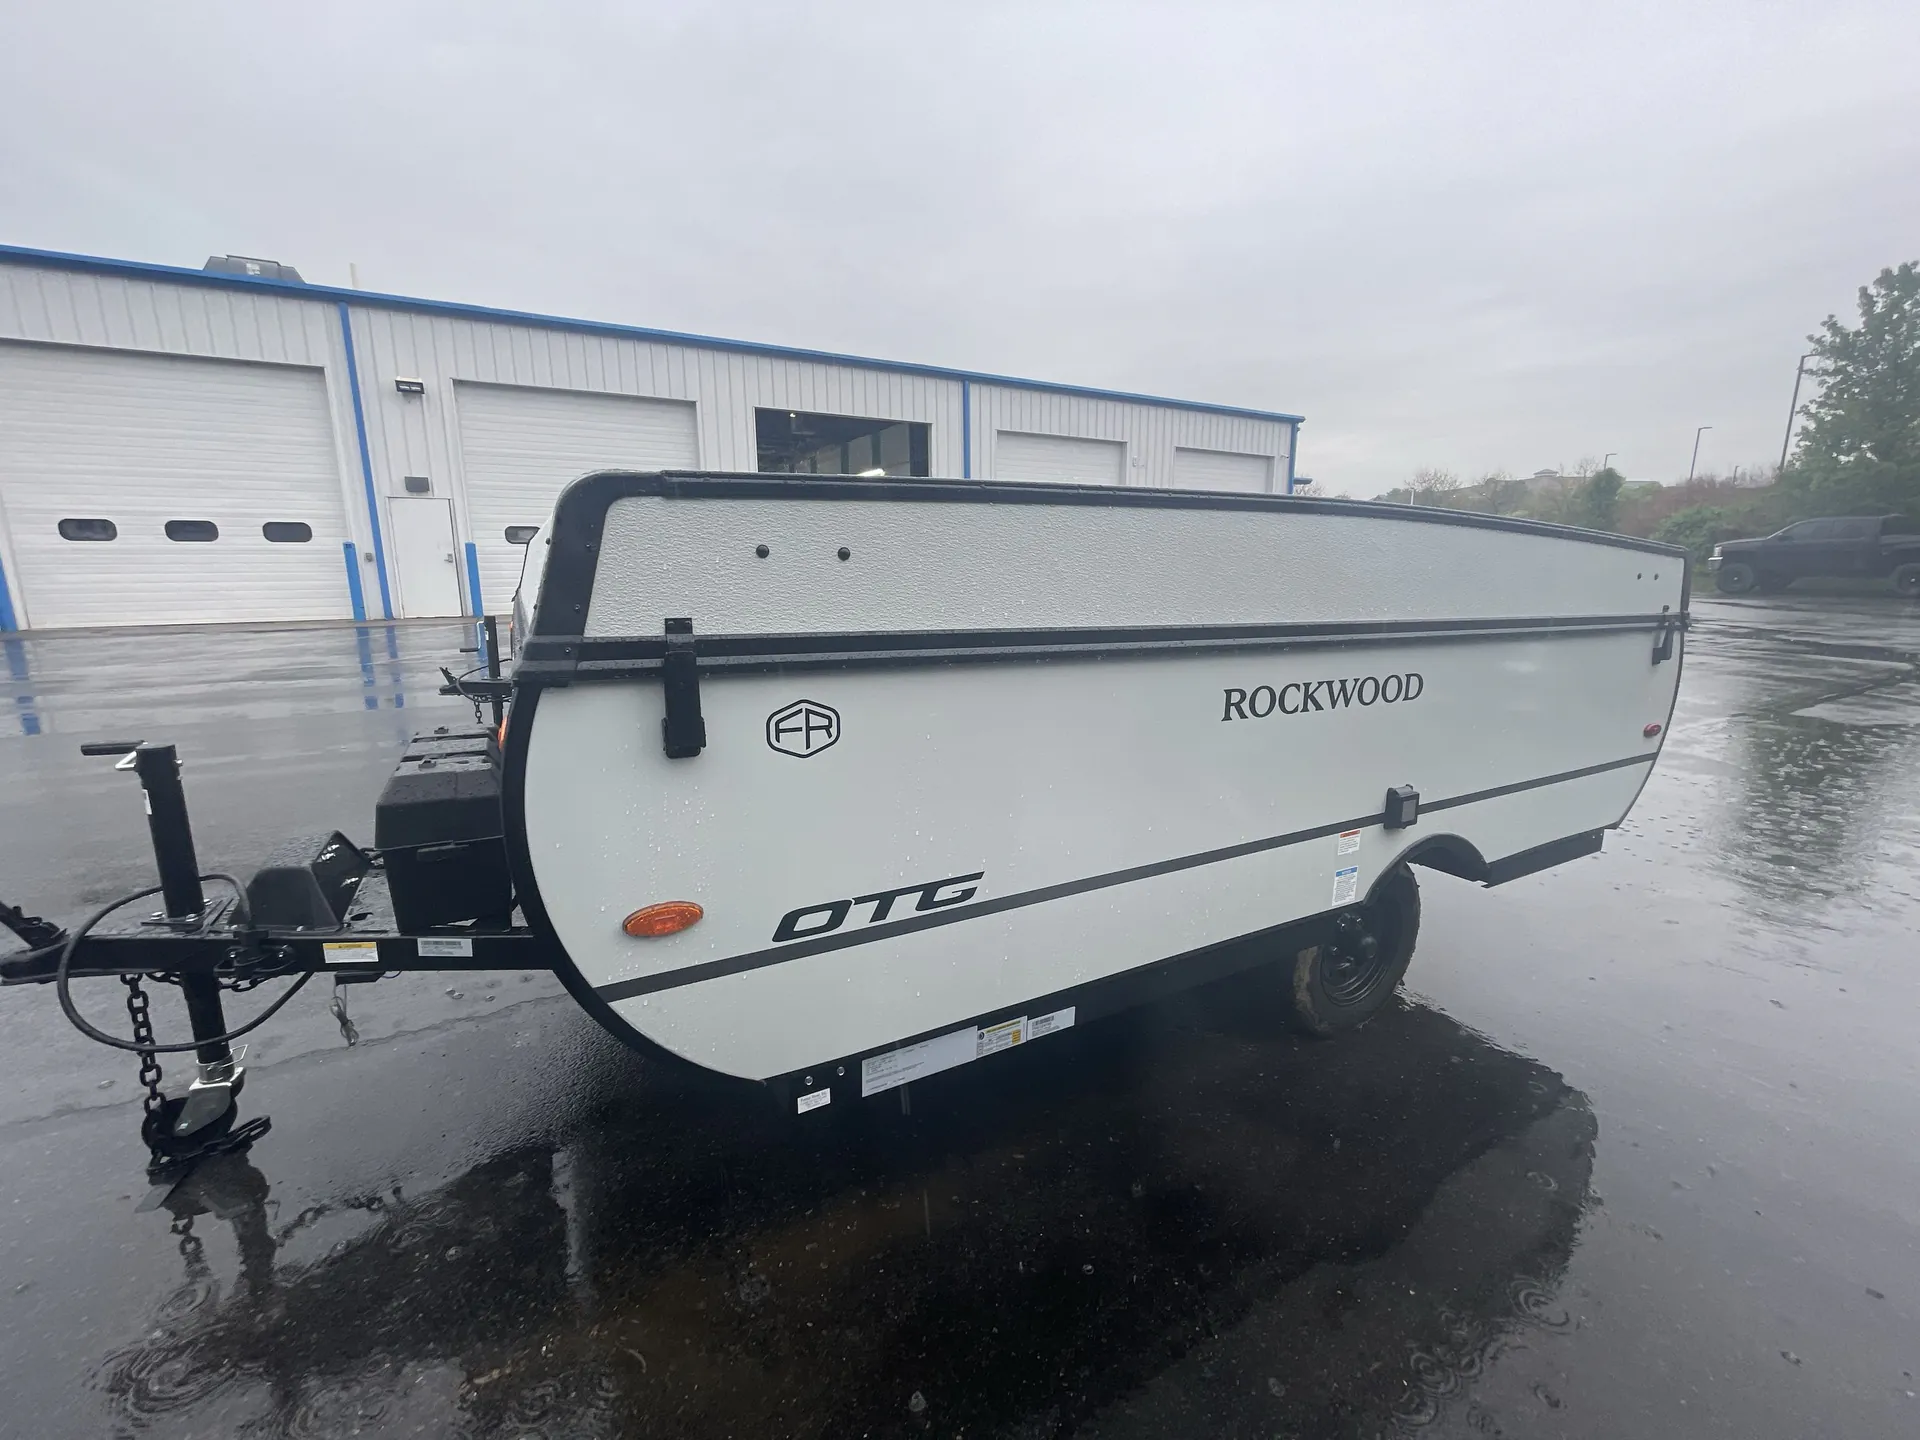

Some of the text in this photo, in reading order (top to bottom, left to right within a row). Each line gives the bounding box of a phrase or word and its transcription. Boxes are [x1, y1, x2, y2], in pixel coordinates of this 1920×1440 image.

[1221, 673, 1424, 721] ROCKWOOD
[774, 707, 833, 751] FR
[771, 871, 985, 943] OTG
